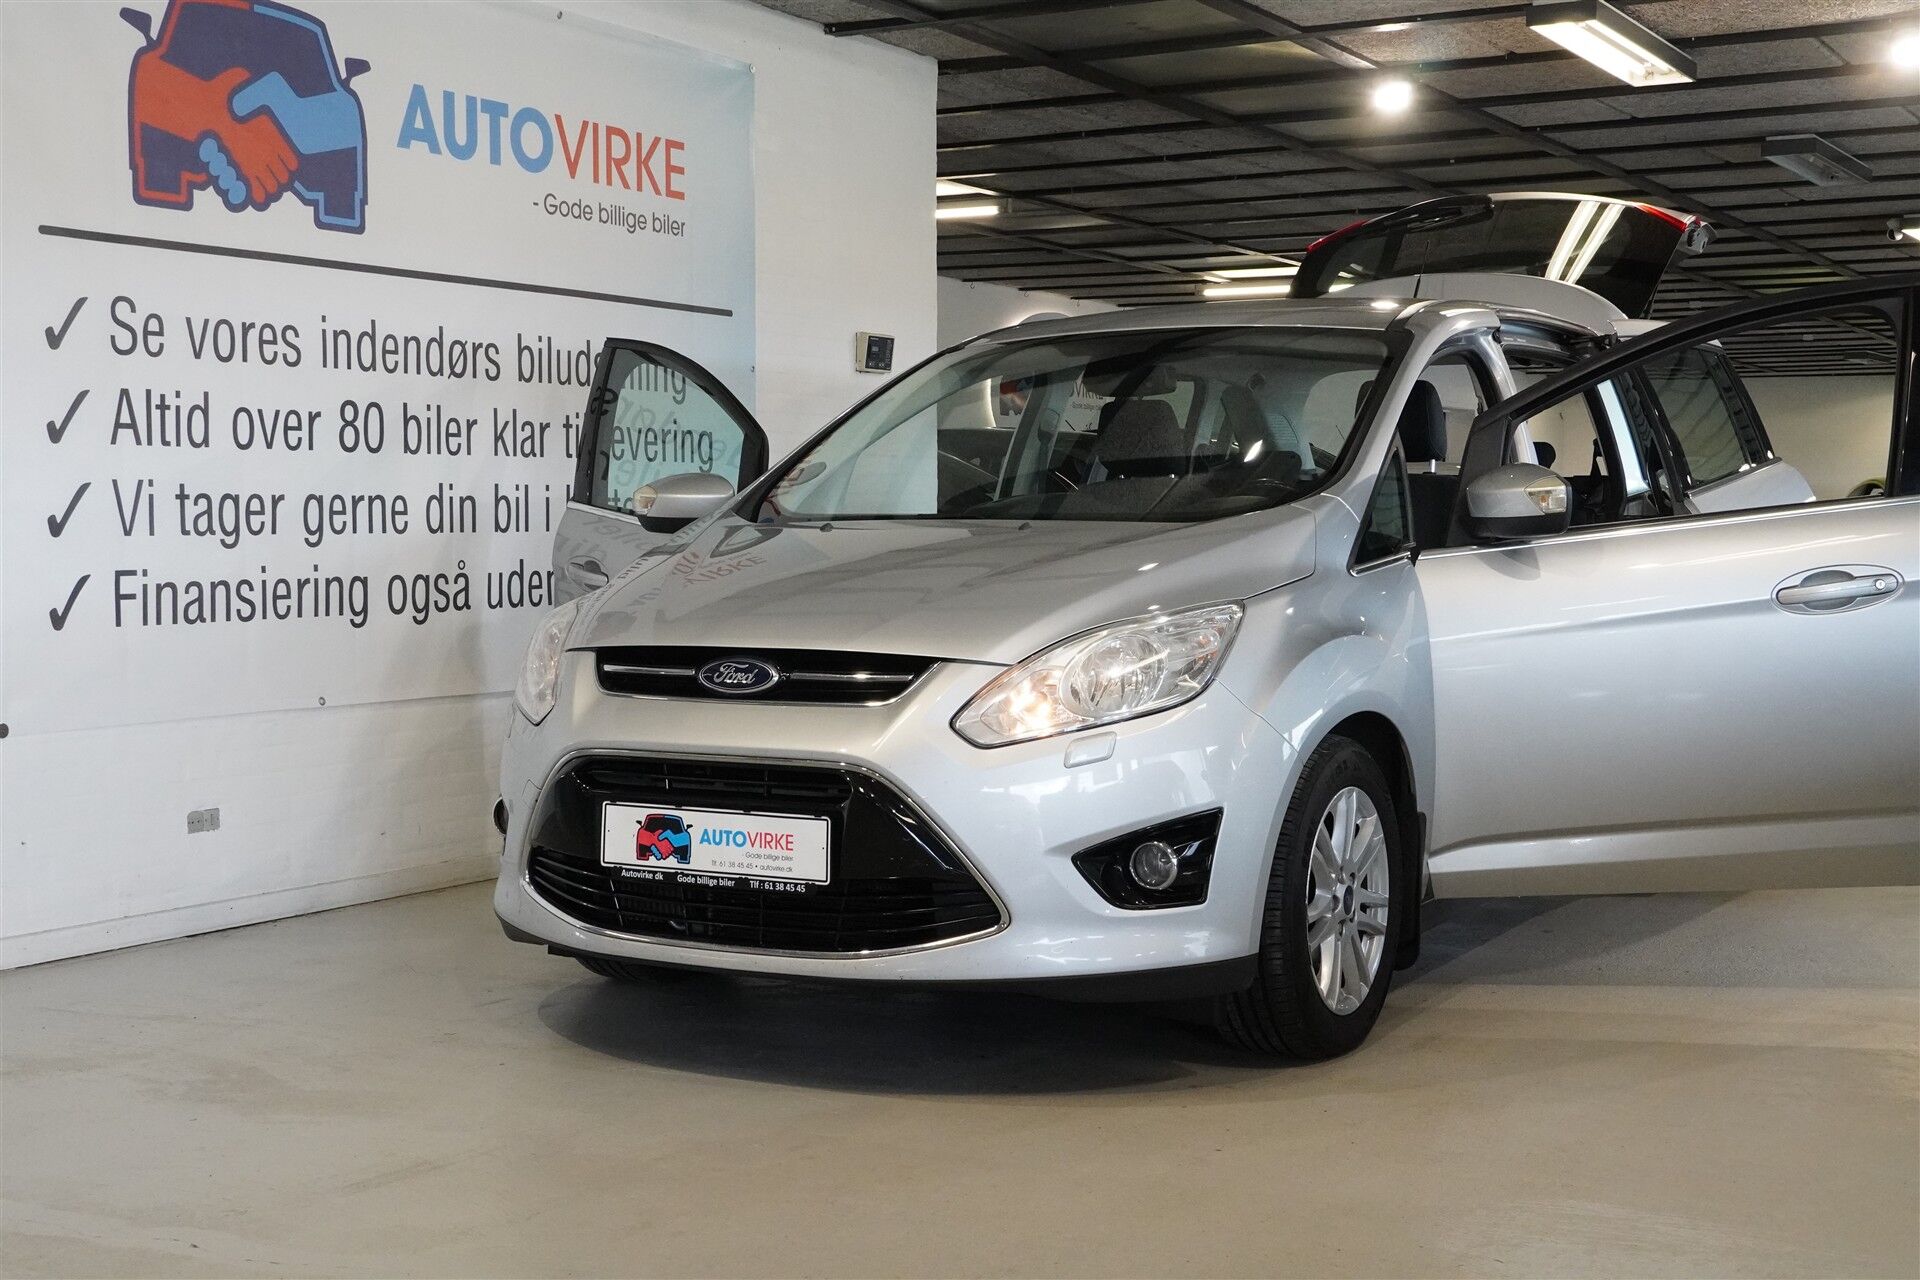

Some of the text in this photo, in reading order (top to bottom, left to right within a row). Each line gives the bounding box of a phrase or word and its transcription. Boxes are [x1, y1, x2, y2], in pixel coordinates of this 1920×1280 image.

[397, 83, 686, 201] AUTOVIRKE
[543, 193, 593, 221] Gode
[598, 202, 647, 234] billige
[652, 212, 686, 237] biler
[111, 296, 165, 358] Se
[186, 316, 302, 368] vores
[320, 315, 501, 381] indendørs
[111, 388, 713, 472] Altid over 80 biler klar ti evering
[112, 480, 155, 537] Vi
[175, 483, 285, 549] tager
[303, 494, 409, 548] gerne
[426, 482, 477, 535] din
[494, 484, 530, 534] bil
[545, 484, 550, 533] i
[115, 564, 369, 629] Finansiering
[387, 561, 472, 626] også
[714, 663, 758, 683] Ford
[699, 828, 794, 851] AUTOVIRKE
[745, 851, 761, 860] Gode
[763, 853, 780, 862] billige
[621, 869, 653, 880] Autovirke
[677, 874, 695, 884] Gode
[697, 876, 718, 887] billige
[719, 878, 735, 887] biler
[764, 882, 773, 890] 61
[775, 882, 784, 891] 38
[785, 883, 795, 892] 45
[796, 884, 806, 893] 45
